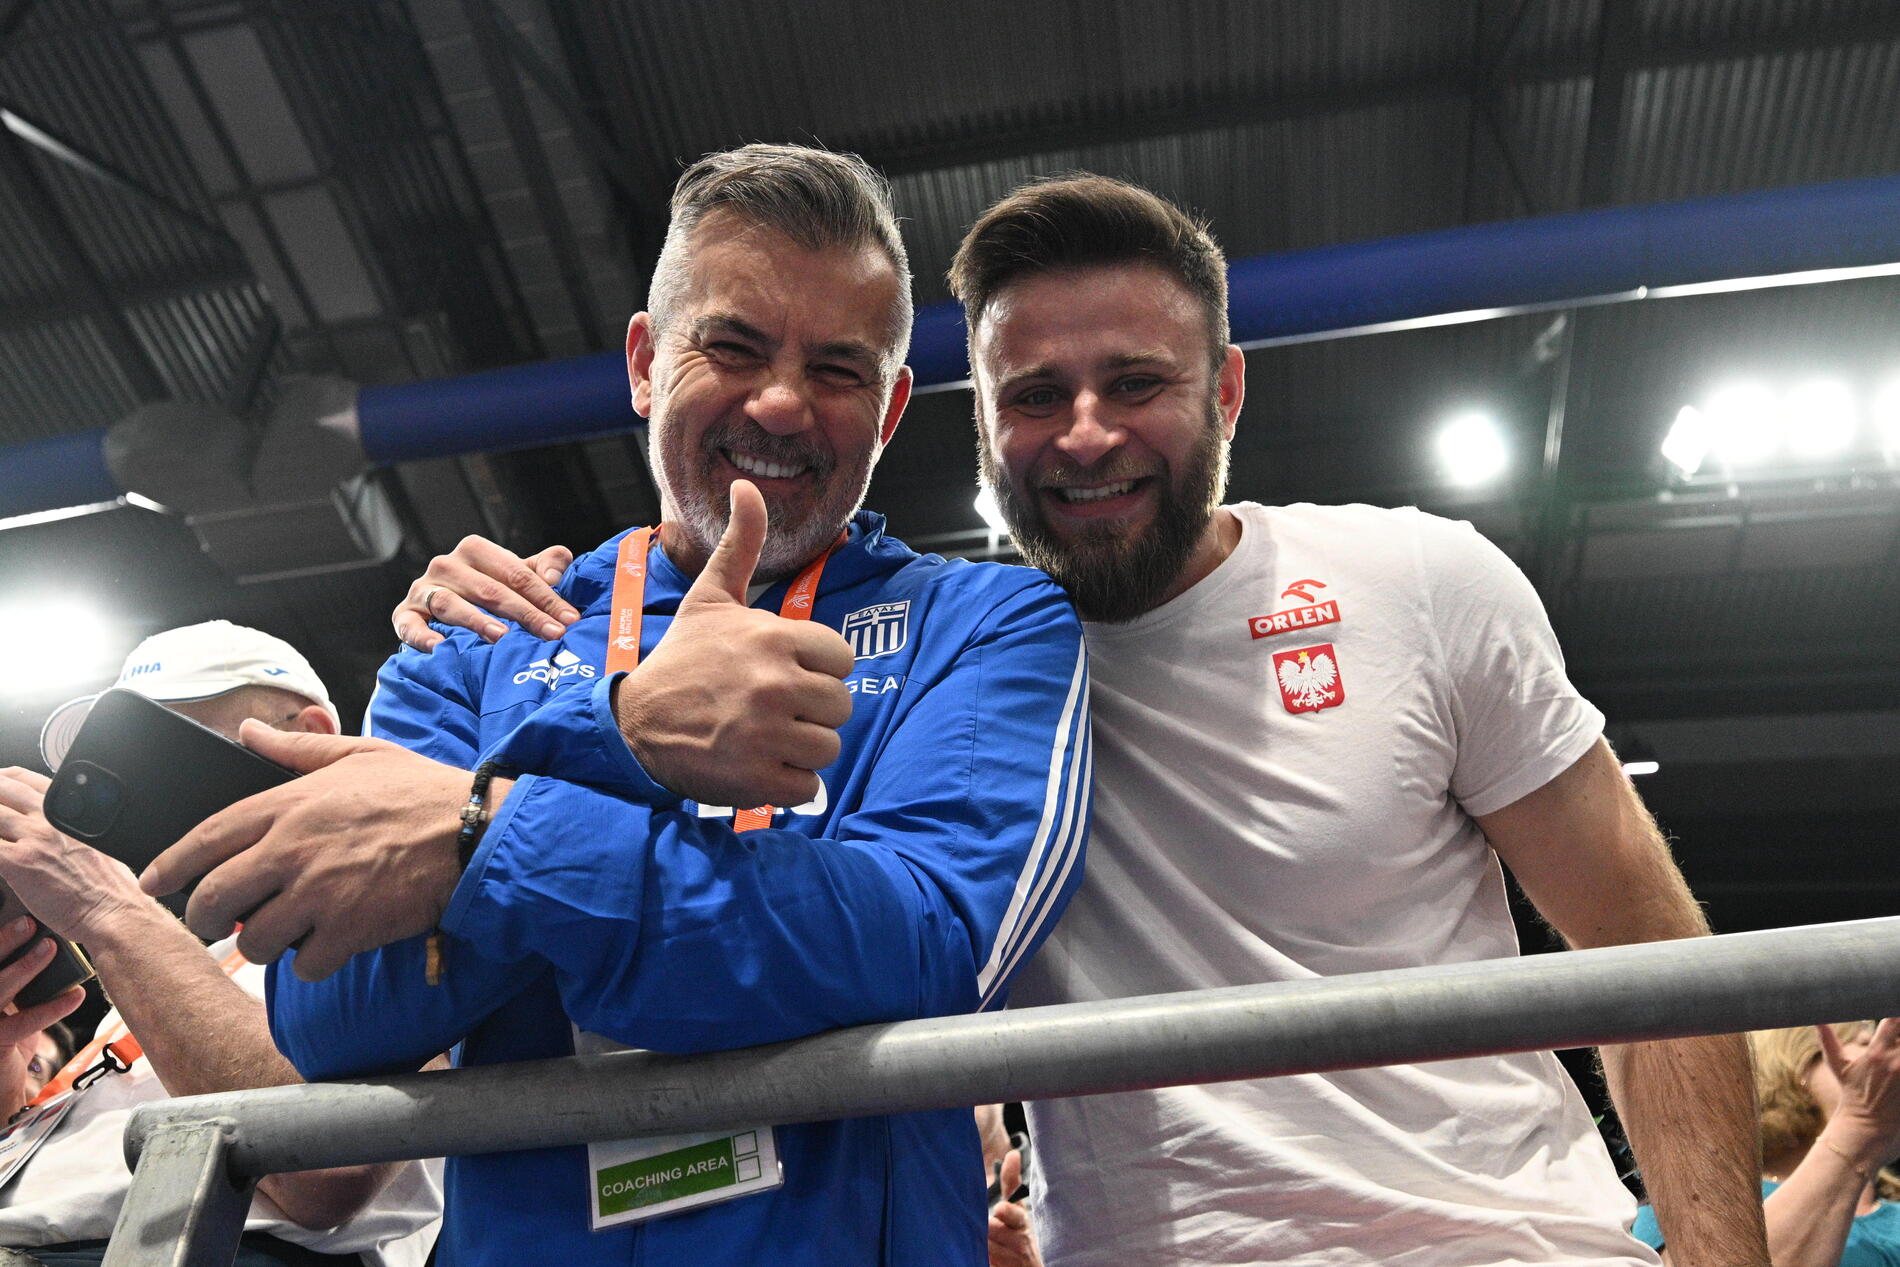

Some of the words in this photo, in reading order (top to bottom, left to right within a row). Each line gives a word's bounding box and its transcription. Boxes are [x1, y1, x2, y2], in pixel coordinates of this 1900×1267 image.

[1254, 604, 1335, 634] ORLEN
[513, 663, 596, 691] adas
[844, 675, 906, 695] GEA
[602, 1167, 683, 1198] COACHING
[686, 1155, 729, 1177] AREA
